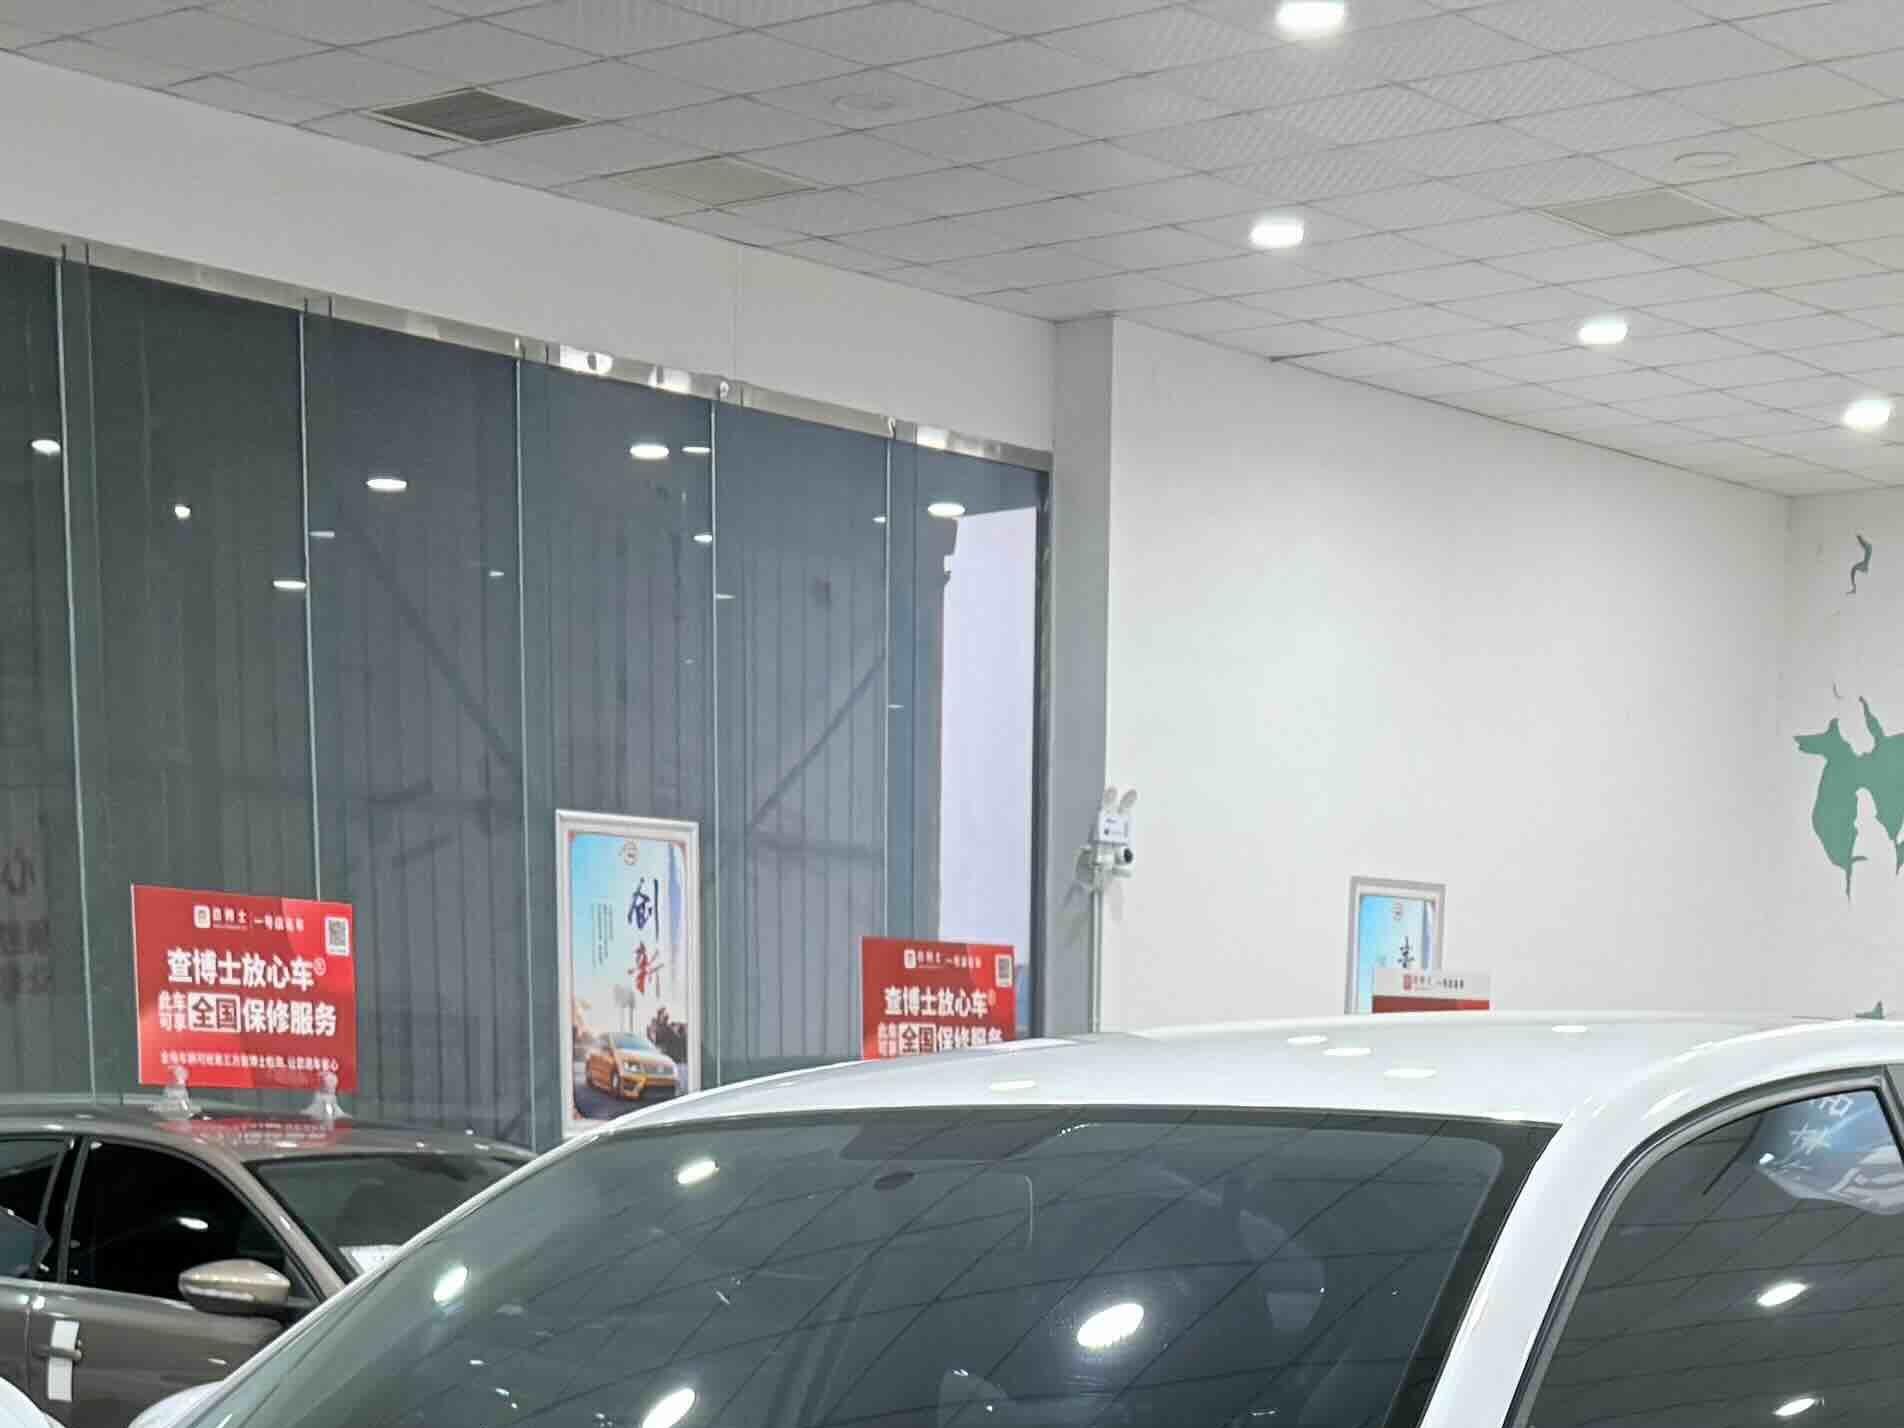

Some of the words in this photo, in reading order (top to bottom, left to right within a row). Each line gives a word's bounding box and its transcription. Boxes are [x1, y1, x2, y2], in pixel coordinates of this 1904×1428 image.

[192, 994, 337, 1037] 全国保修服务
